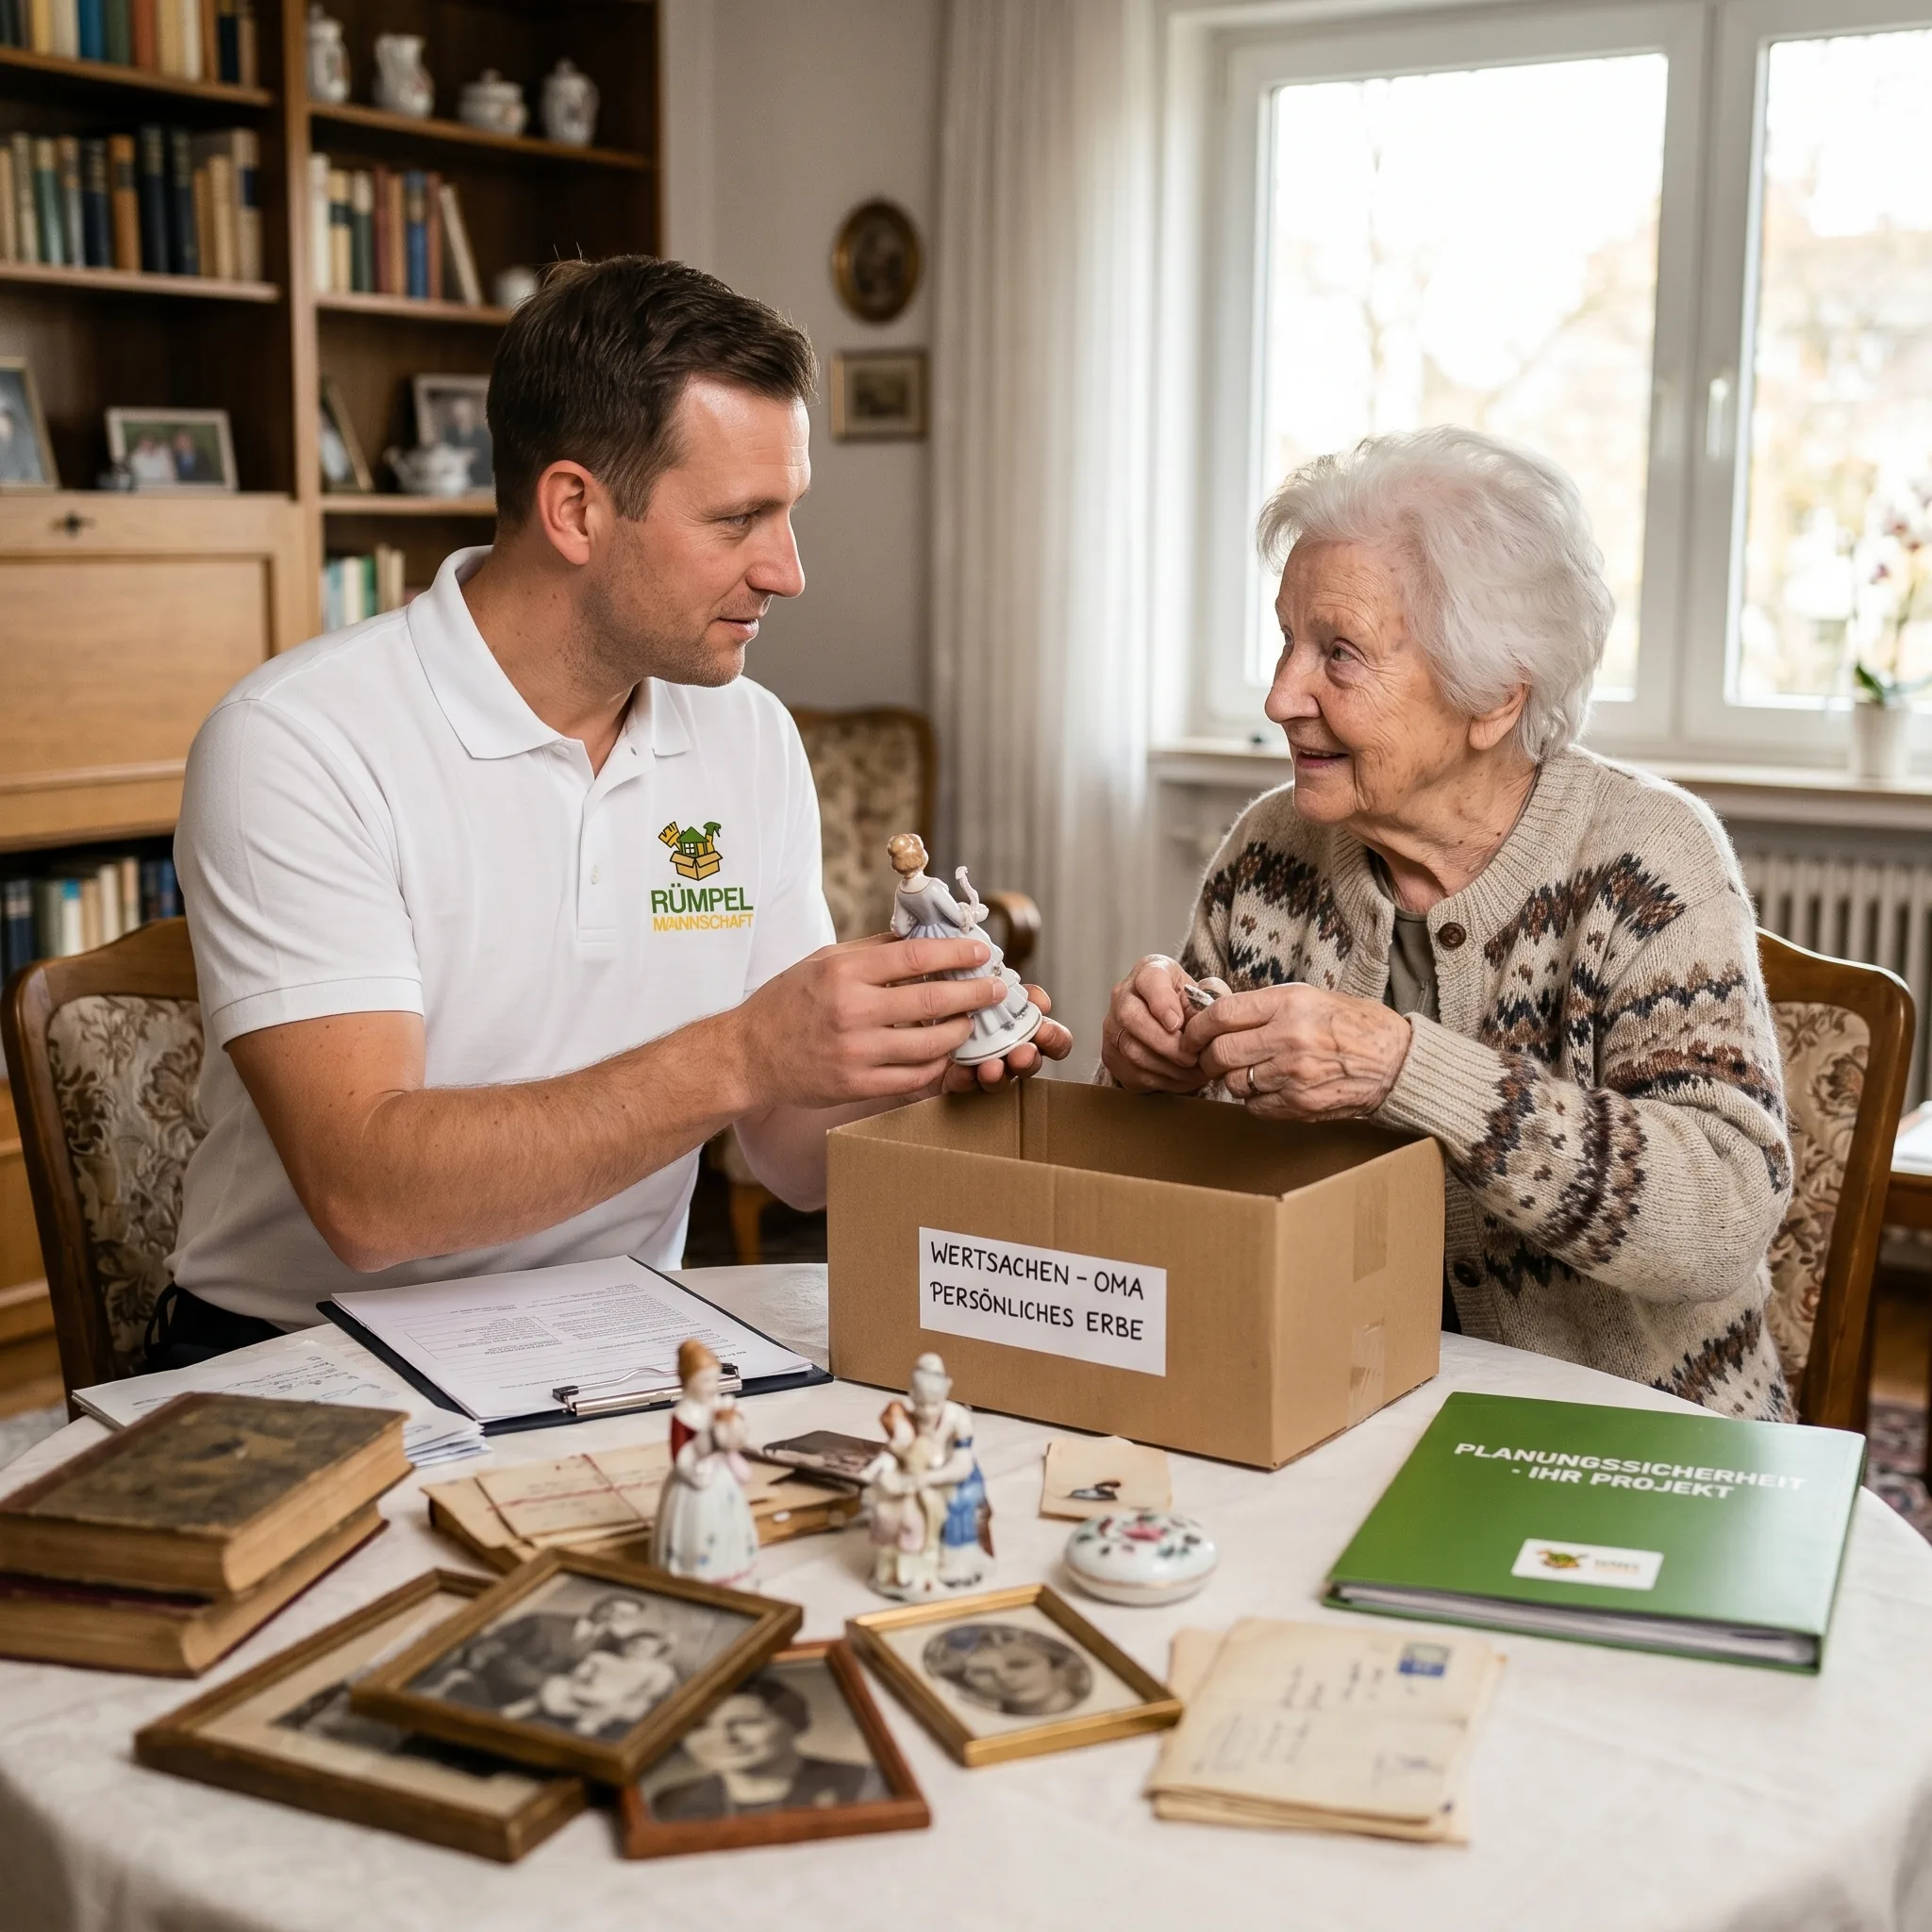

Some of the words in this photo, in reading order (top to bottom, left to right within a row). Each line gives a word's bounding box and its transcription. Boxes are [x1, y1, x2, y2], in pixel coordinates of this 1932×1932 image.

[650, 883, 754, 913] RÜMPEL
[653, 914, 754, 932] MANNSCHAFT
[930, 1241, 1070, 1286] WERTSACHEN
[1094, 1271, 1144, 1301] OMA
[929, 1281, 1074, 1328] PERSÖNLICHES
[1086, 1311, 1144, 1341] ERBE
[1454, 1442, 1807, 1491] PLANUNGSSICHERHEIT
[1528, 1466, 1583, 1484] IHR
[1590, 1473, 1735, 1499] PROJEKT
